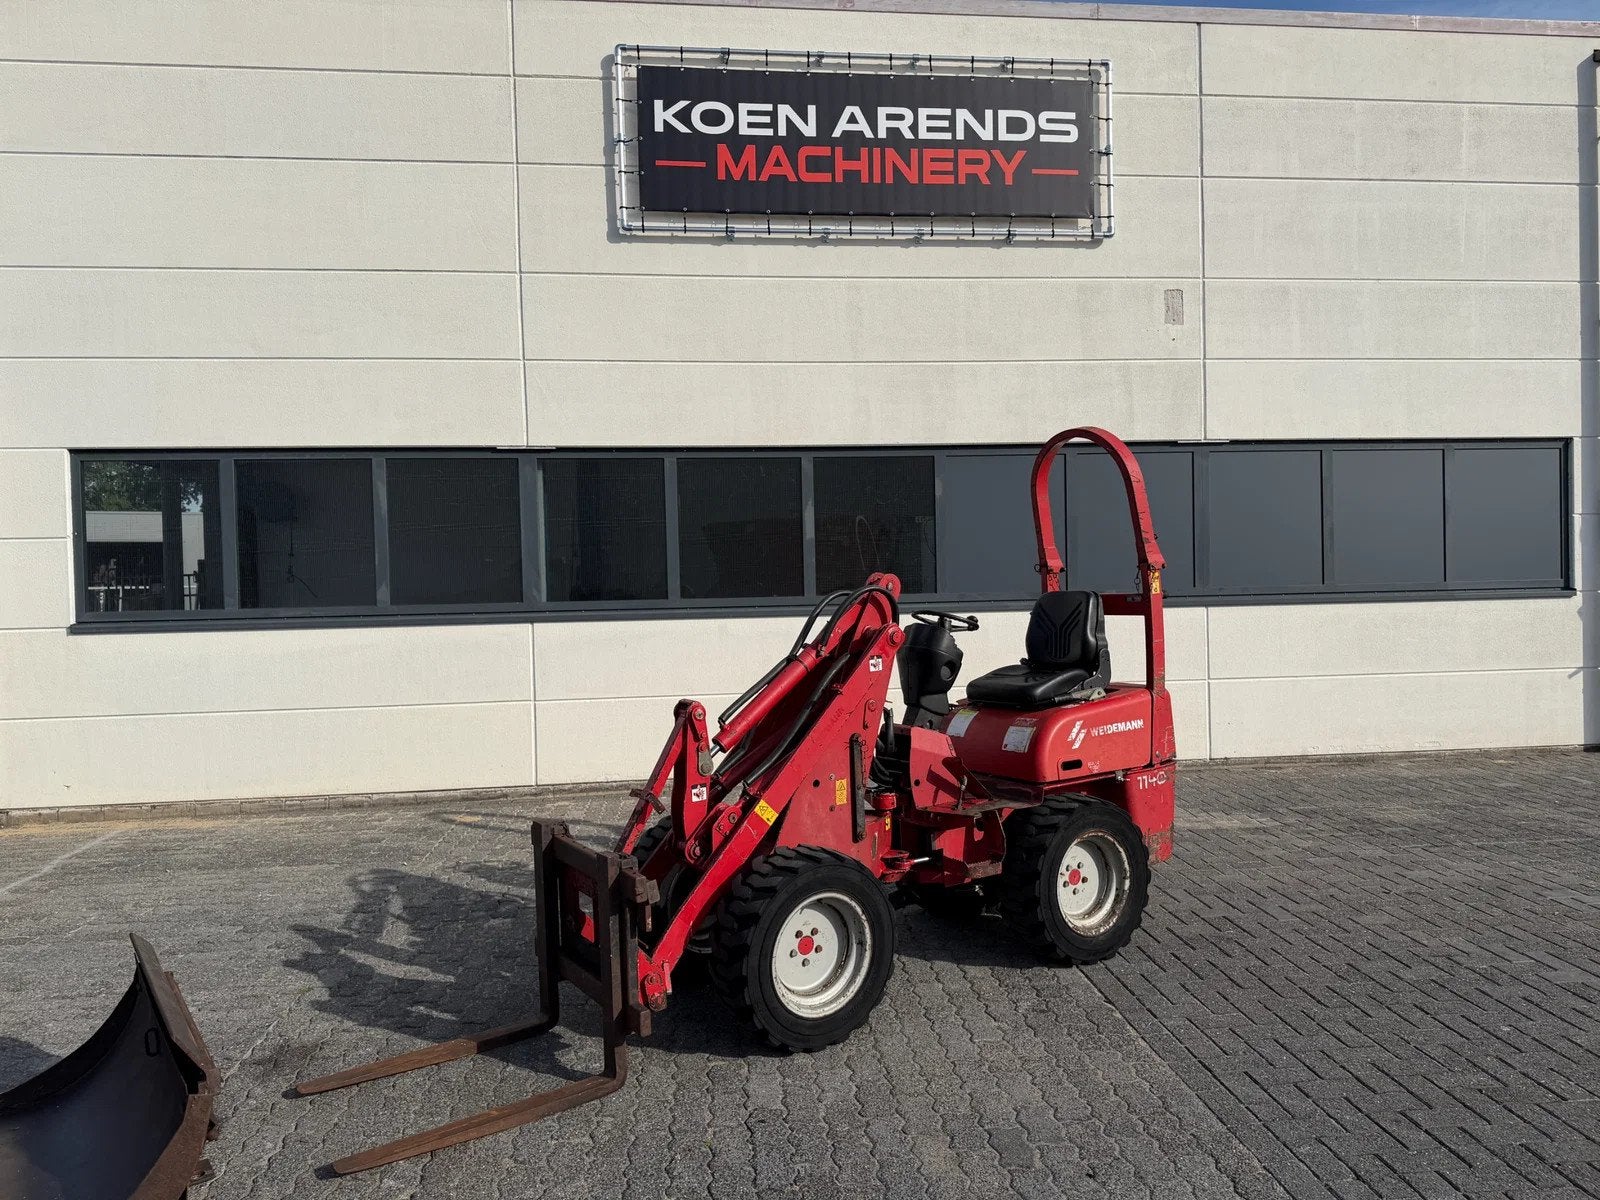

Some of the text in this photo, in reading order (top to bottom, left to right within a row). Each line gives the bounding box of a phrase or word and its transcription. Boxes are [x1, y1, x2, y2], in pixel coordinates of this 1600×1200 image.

[653, 99, 1079, 143] KOEN ARENDS
[716, 143, 1027, 185] MACHINERY
[1090, 719, 1144, 737] WEIDEMANN
[1137, 771, 1167, 790] 1140
